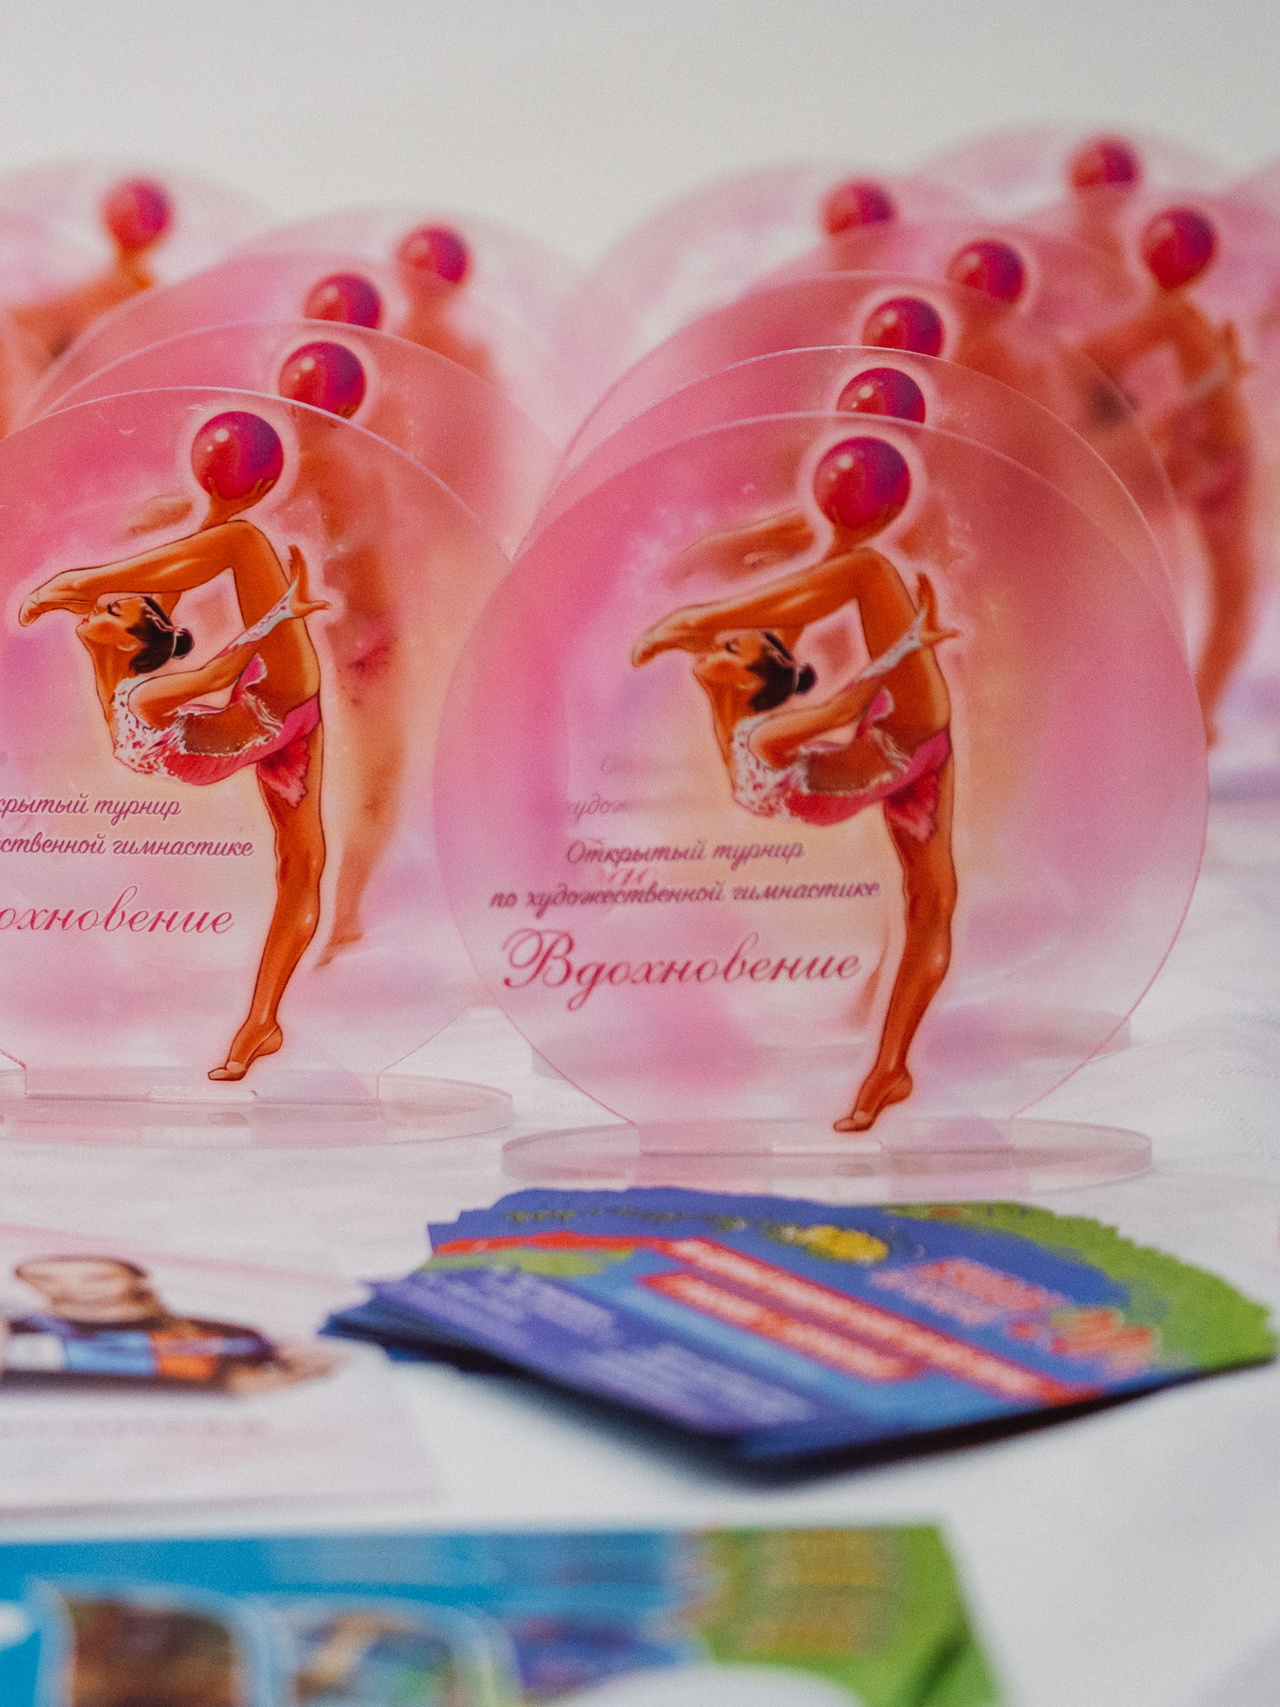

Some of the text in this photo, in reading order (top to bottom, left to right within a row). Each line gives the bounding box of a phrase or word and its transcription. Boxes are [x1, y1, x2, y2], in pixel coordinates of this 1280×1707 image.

[93, 796, 183, 827] турнир
[111, 838, 255, 857] гимнастике
[565, 838, 806, 872] Открытый турнир
[489, 881, 882, 919] по художественной гимнастике
[501, 928, 862, 1012] Вдохновение
